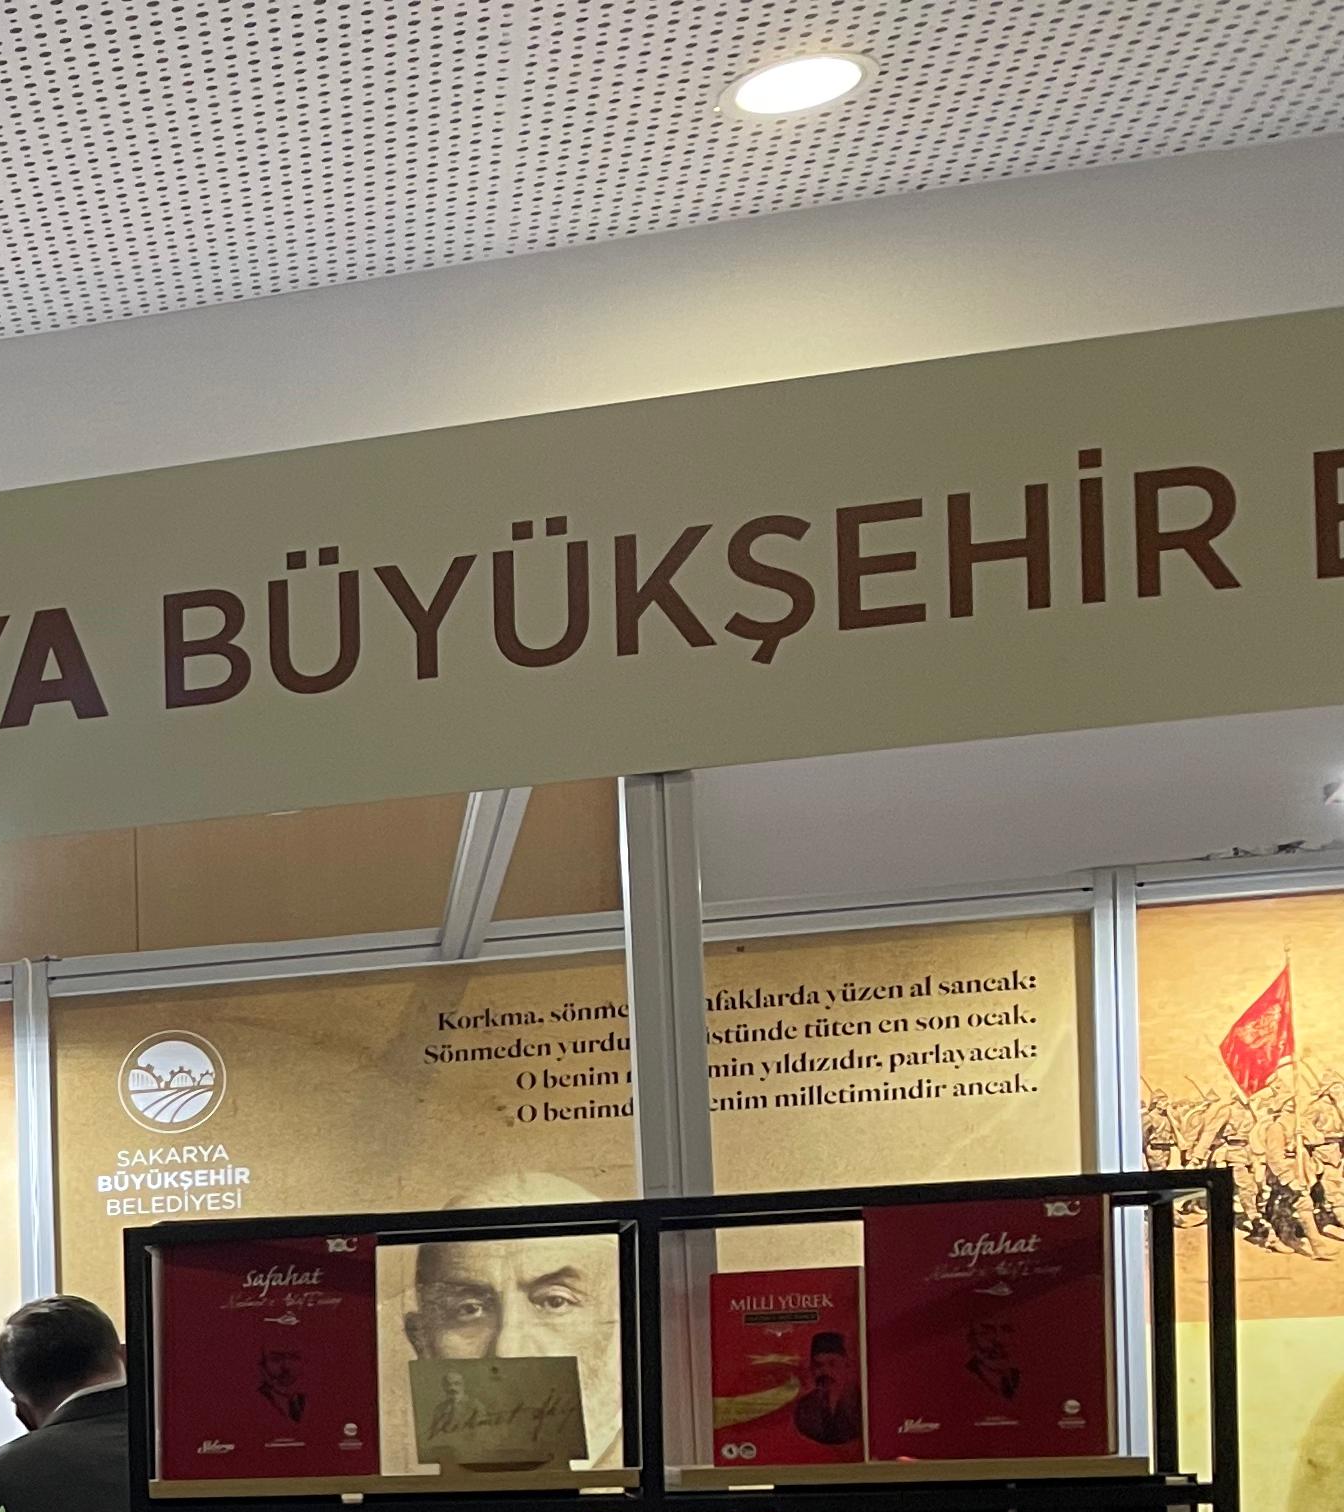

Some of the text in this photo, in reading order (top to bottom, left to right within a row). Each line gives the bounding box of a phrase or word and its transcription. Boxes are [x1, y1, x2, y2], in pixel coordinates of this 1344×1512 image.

[165, 446, 1242, 709] BÜYÜKŞEHİR
[550, 1003, 629, 1022] sönme
[826, 982, 904, 1009] yüzen
[910, 976, 932, 998] al
[424, 1038, 551, 1064] Sönmeden
[707, 1020, 797, 1044] stünde
[804, 1018, 872, 1040] tüten
[879, 1016, 909, 1034] en
[915, 1014, 960, 1031] son
[967, 1004, 1037, 1027] ocak.
[517, 1071, 536, 1090] O
[544, 1067, 618, 1088] benim
[760, 1050, 883, 1081] yıldızıdır,
[517, 1104, 536, 1123] O
[709, 1090, 768, 1111] enim
[775, 1079, 948, 1108] milletimindir
[953, 1073, 1037, 1096] ancak.
[117, 1144, 229, 1167] SAKARYA
[97, 1164, 250, 1191] BÜYÜKŞEHİR
[106, 1188, 242, 1216] BELEDİYESİ
